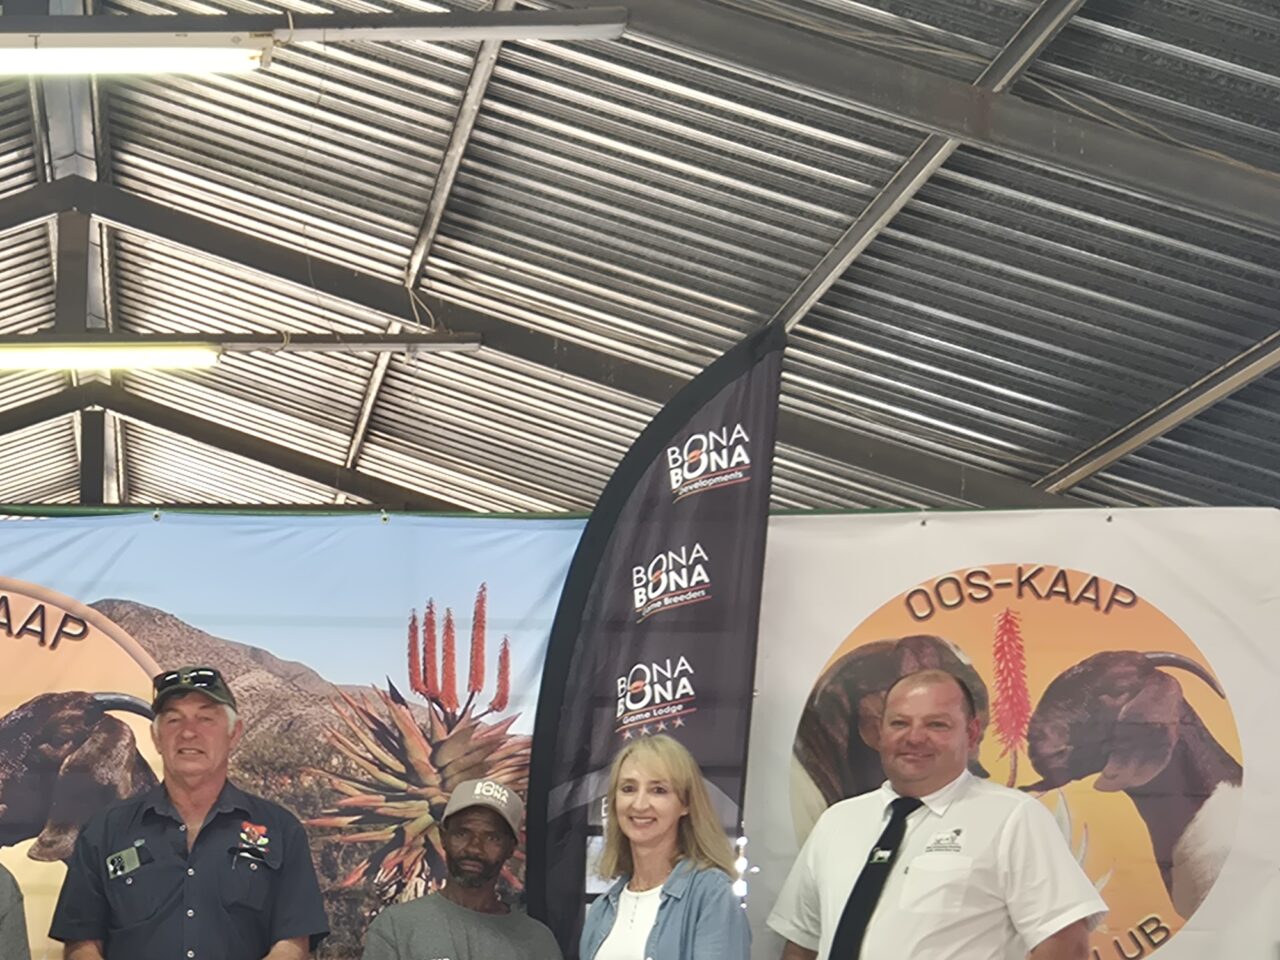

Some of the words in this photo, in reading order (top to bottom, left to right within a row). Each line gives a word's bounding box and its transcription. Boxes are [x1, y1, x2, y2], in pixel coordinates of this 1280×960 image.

[667, 423, 750, 468] BONA
[670, 444, 751, 489] BONA
[632, 543, 708, 587] BONA
[634, 564, 710, 608] BONA
[905, 566, 1137, 621] OOS-KAAP
[616, 677, 695, 717] BONA
[617, 655, 694, 697] BONA
[623, 711, 651, 724] Game
[652, 704, 683, 717] Lodge
